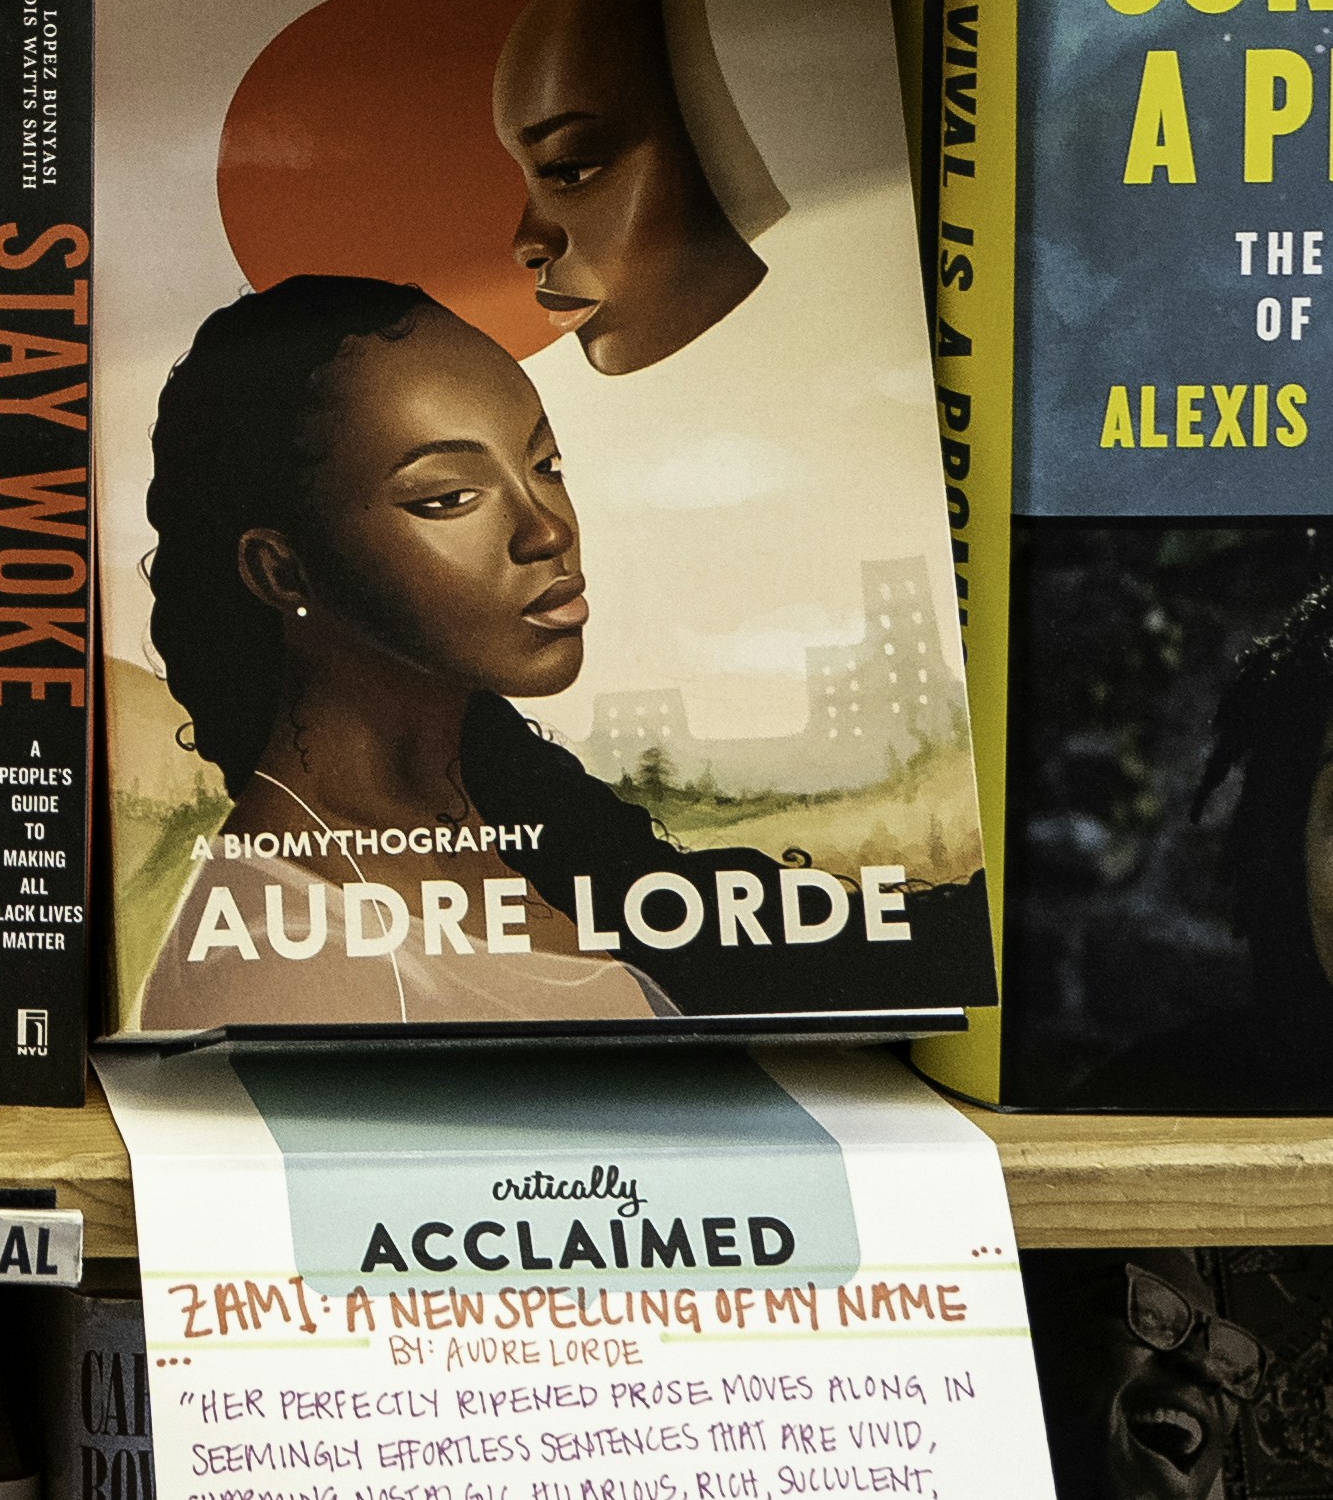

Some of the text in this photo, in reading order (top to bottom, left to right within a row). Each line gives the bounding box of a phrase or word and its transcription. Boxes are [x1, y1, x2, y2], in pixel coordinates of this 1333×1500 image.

[190, 866, 913, 960] AUDRE LORDE
[16, 1041, 49, 1060] NYU
[493, 1165, 647, 1217] critically
[361, 1217, 795, 1272] ACCLAIMED
[280, 1389, 438, 1420] PERFECTLY
[611, 1380, 713, 1409] PROSE
[721, 1374, 813, 1405] MOVES
[829, 1375, 927, 1405] ALONG
[944, 1371, 975, 1402] IN
